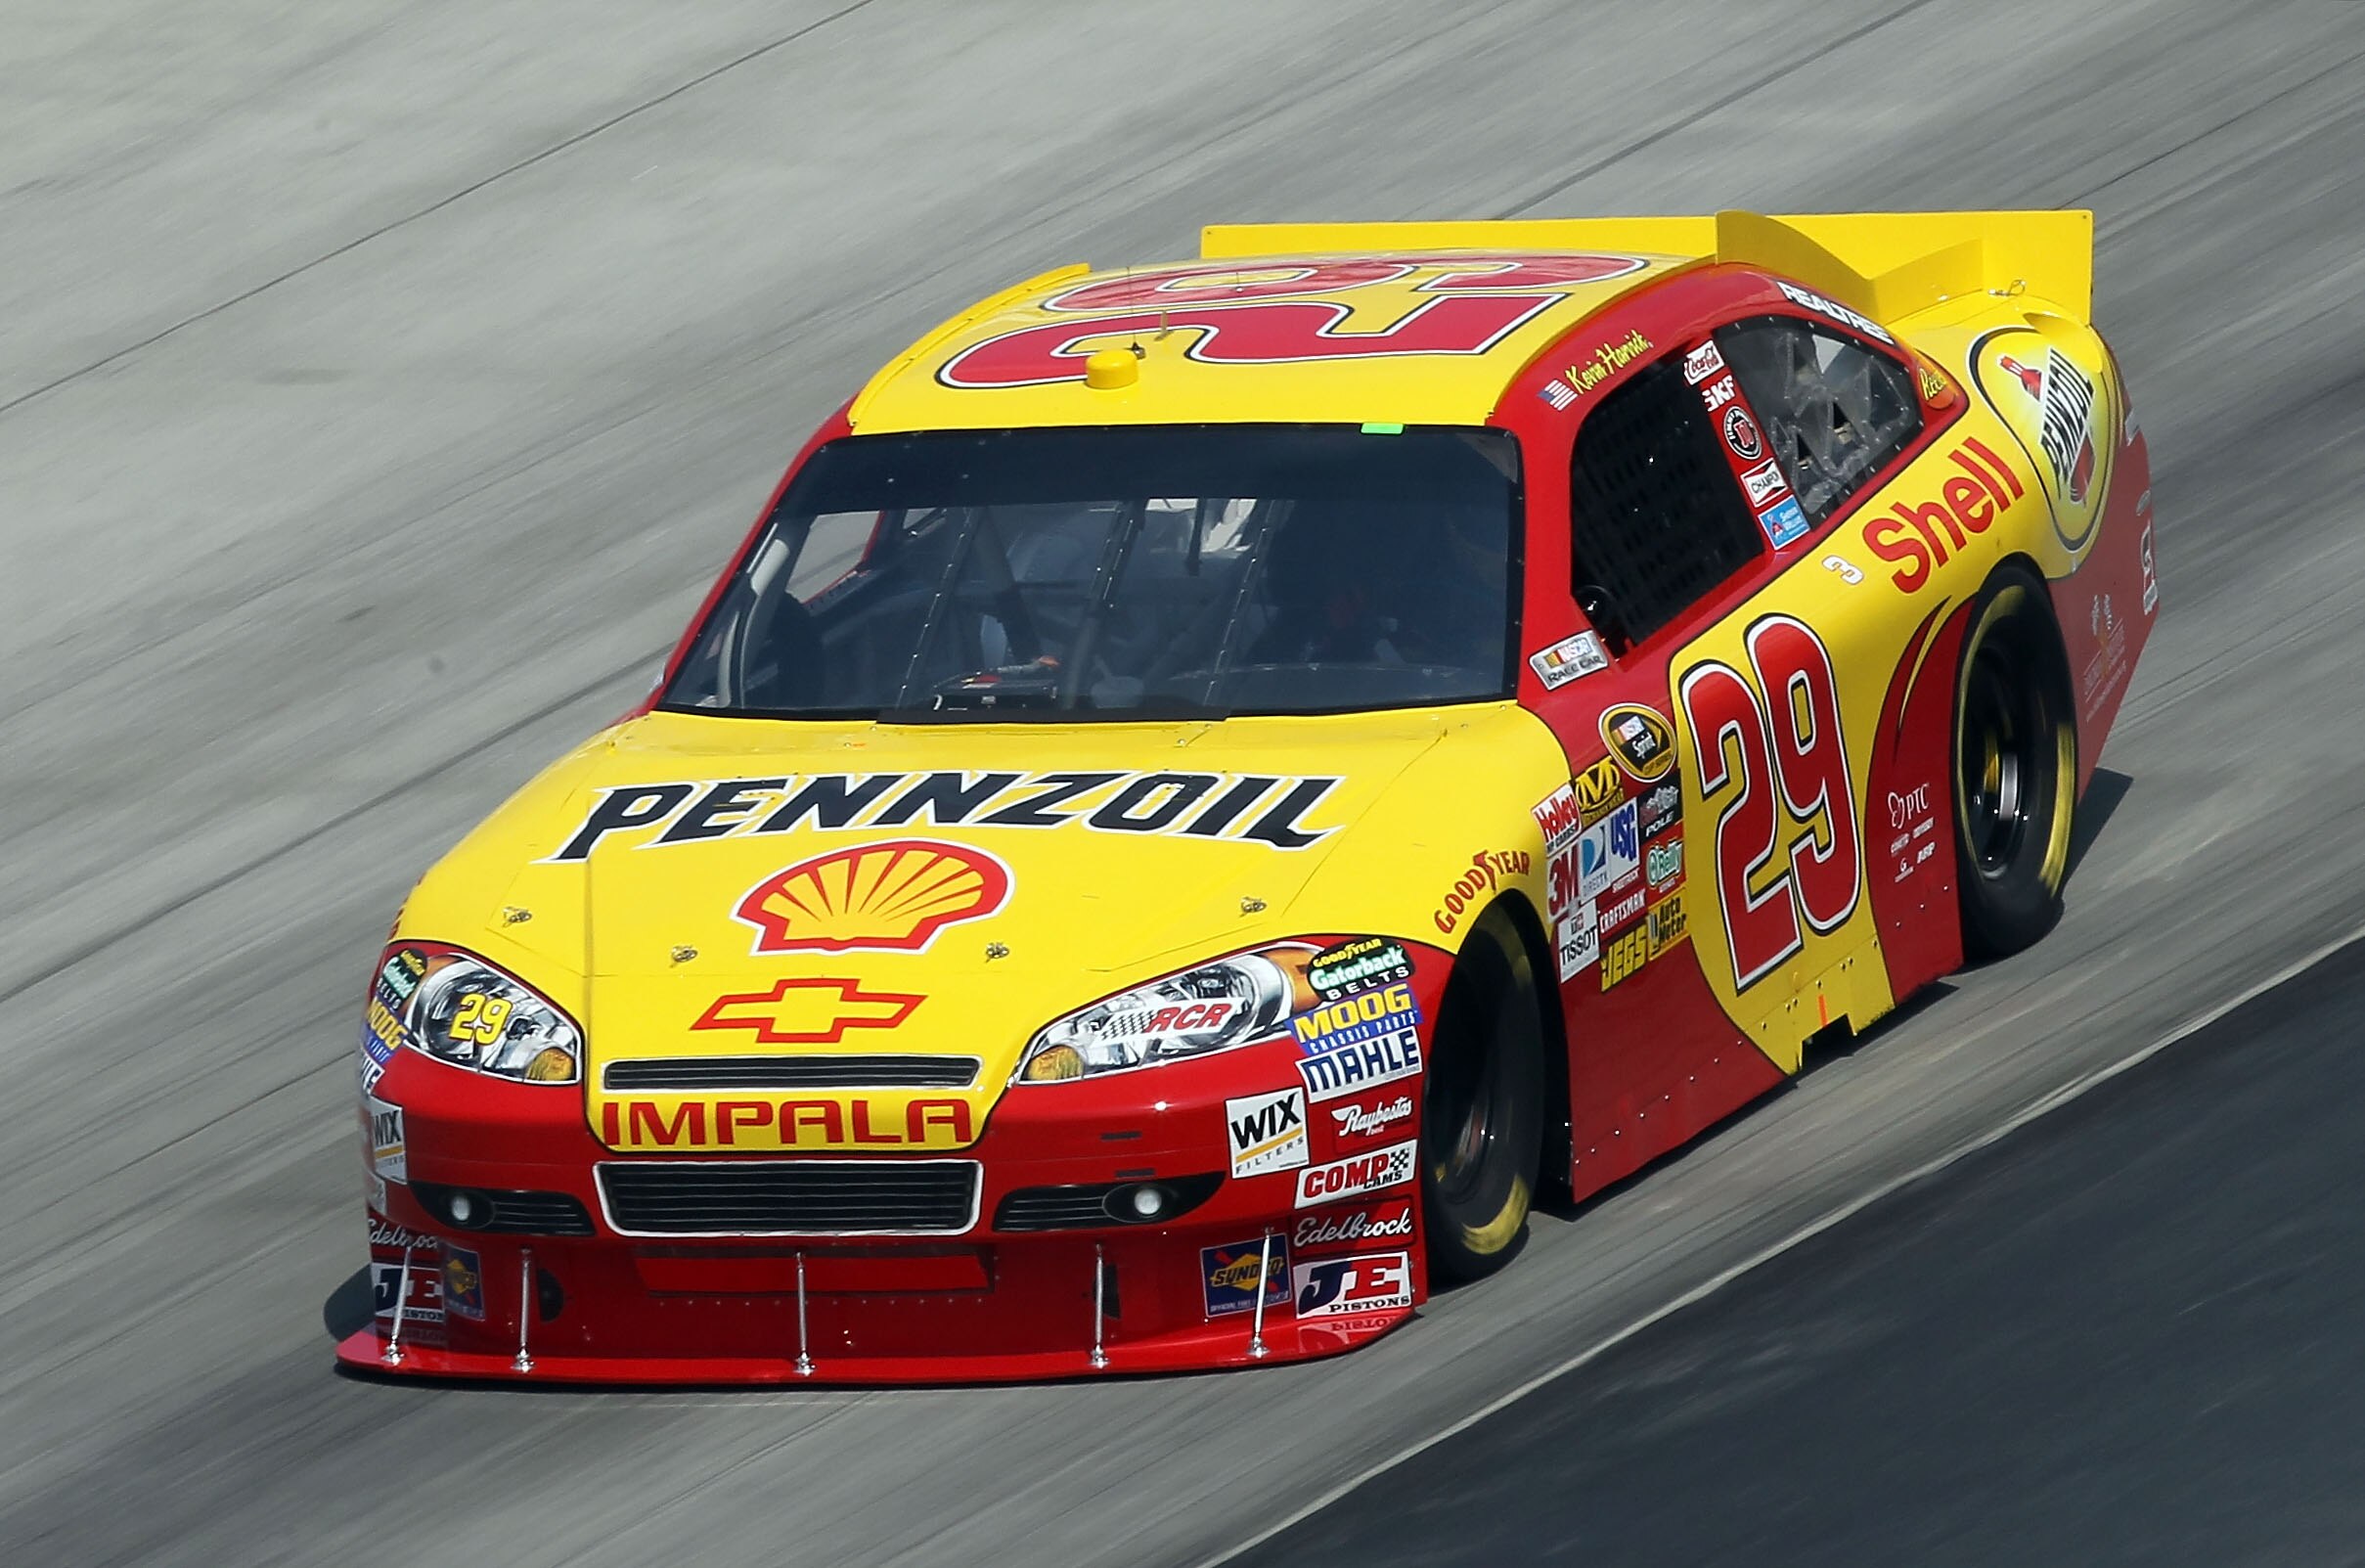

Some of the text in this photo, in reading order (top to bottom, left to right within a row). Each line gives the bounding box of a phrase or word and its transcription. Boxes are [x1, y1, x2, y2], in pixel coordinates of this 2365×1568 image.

[934, 255, 1655, 393] 29
[1776, 281, 1897, 346] REALTREE
[1565, 329, 1651, 394] Kevin Harvick
[1702, 375, 1735, 412] SKF
[1862, 436, 2026, 594] Shell
[1579, 654, 1605, 669] CAR
[543, 770, 1346, 861] PENNZOIL
[1534, 793, 1577, 842] Holley
[1645, 811, 1674, 838] POLE
[1677, 612, 1862, 997] 29
[1906, 784, 1929, 820] PTC
[1610, 803, 1637, 862] USG
[1434, 849, 1531, 934] GOODYEAR
[1548, 843, 1580, 917] 3M
[1600, 888, 1646, 934] CRAFTSMAN
[1659, 896, 1680, 923] Auto
[1313, 938, 1382, 967] GOODYEAR
[1559, 925, 1598, 966] TISSOT
[1600, 923, 1648, 992] JEGS
[1309, 947, 1406, 991] Gatorback
[1326, 966, 1409, 1001] BELTS
[449, 993, 513, 1045] 29
[1144, 1004, 1232, 1033] RCR
[1294, 983, 1411, 1044] MOOG
[1309, 1011, 1416, 1054] CHASSIS PARTS
[1300, 1029, 1420, 1094] MAHLE
[602, 1099, 971, 1146] IMPALA
[1230, 1092, 1301, 1149] WIX
[1331, 1096, 1412, 1137] Raybestos
[1235, 1137, 1304, 1175] FILTERS
[1304, 1153, 1389, 1188] COMP
[1363, 1170, 1404, 1190] CAMS
[1294, 1208, 1411, 1247] Edelbrock
[1299, 1256, 1405, 1317] JE
[1329, 1295, 1410, 1314] PISTONS
